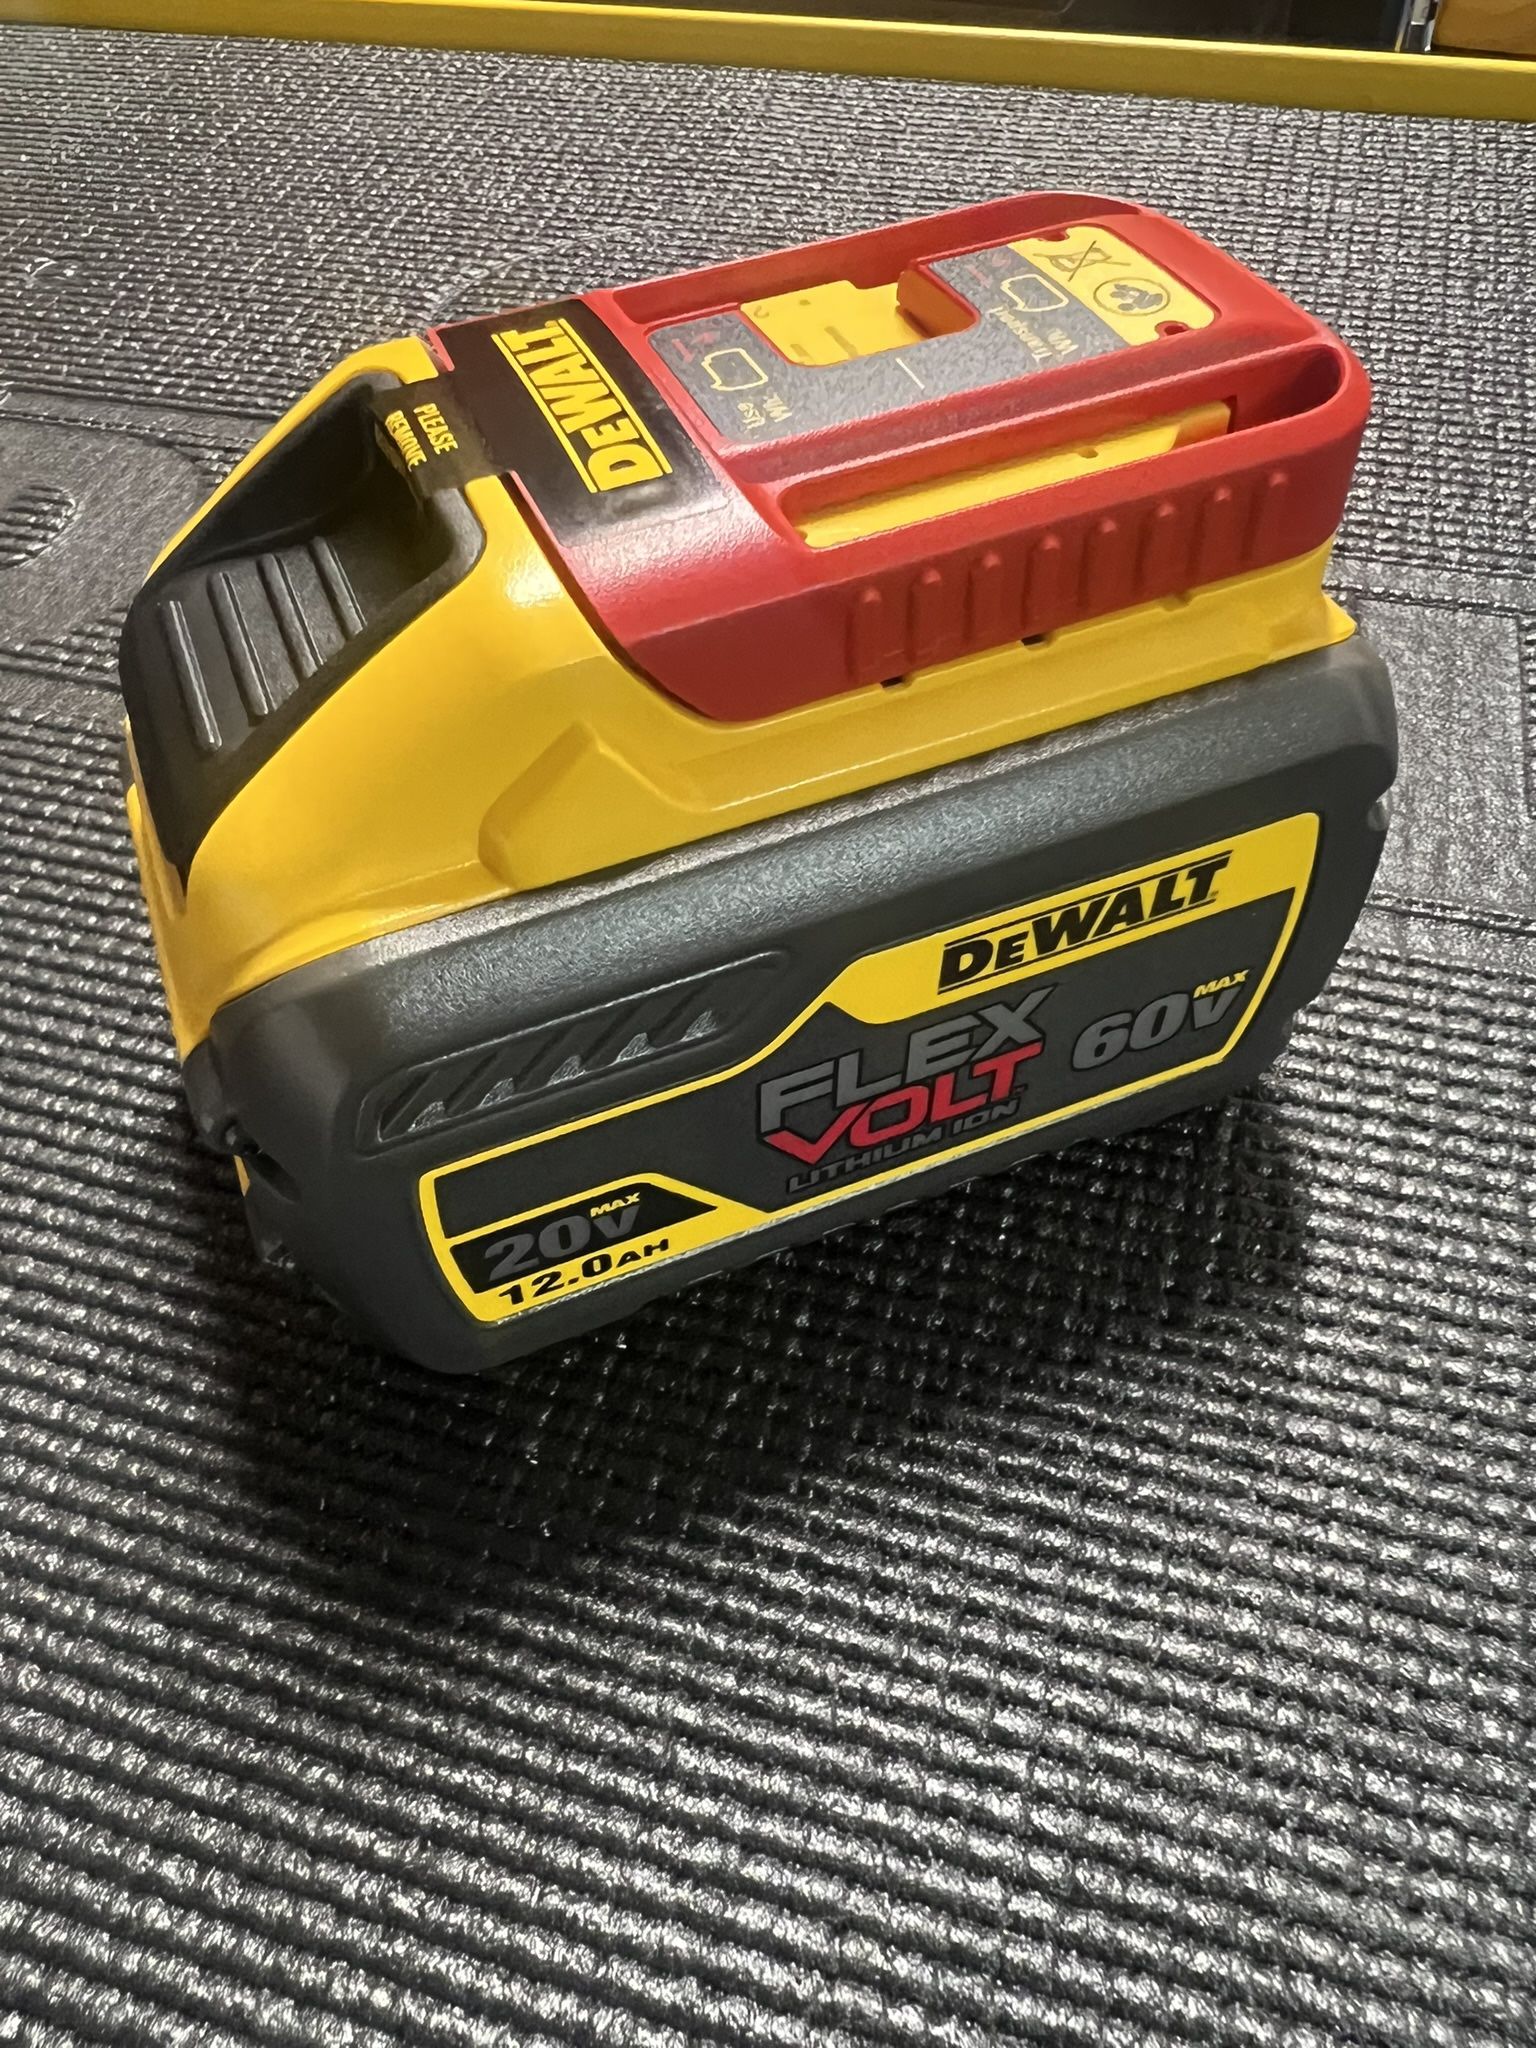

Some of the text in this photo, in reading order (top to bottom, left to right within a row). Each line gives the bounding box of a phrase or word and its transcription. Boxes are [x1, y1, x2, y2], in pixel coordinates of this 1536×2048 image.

[385, 409, 427, 472] REMOVE
[413, 402, 459, 454] PLEASE
[1193, 969, 1250, 999] MAX
[760, 984, 1055, 1132] FLEX
[767, 1041, 1043, 1165] VOLT
[787, 1098, 1020, 1194] LITHIUM ION
[589, 1192, 641, 1218] MAX
